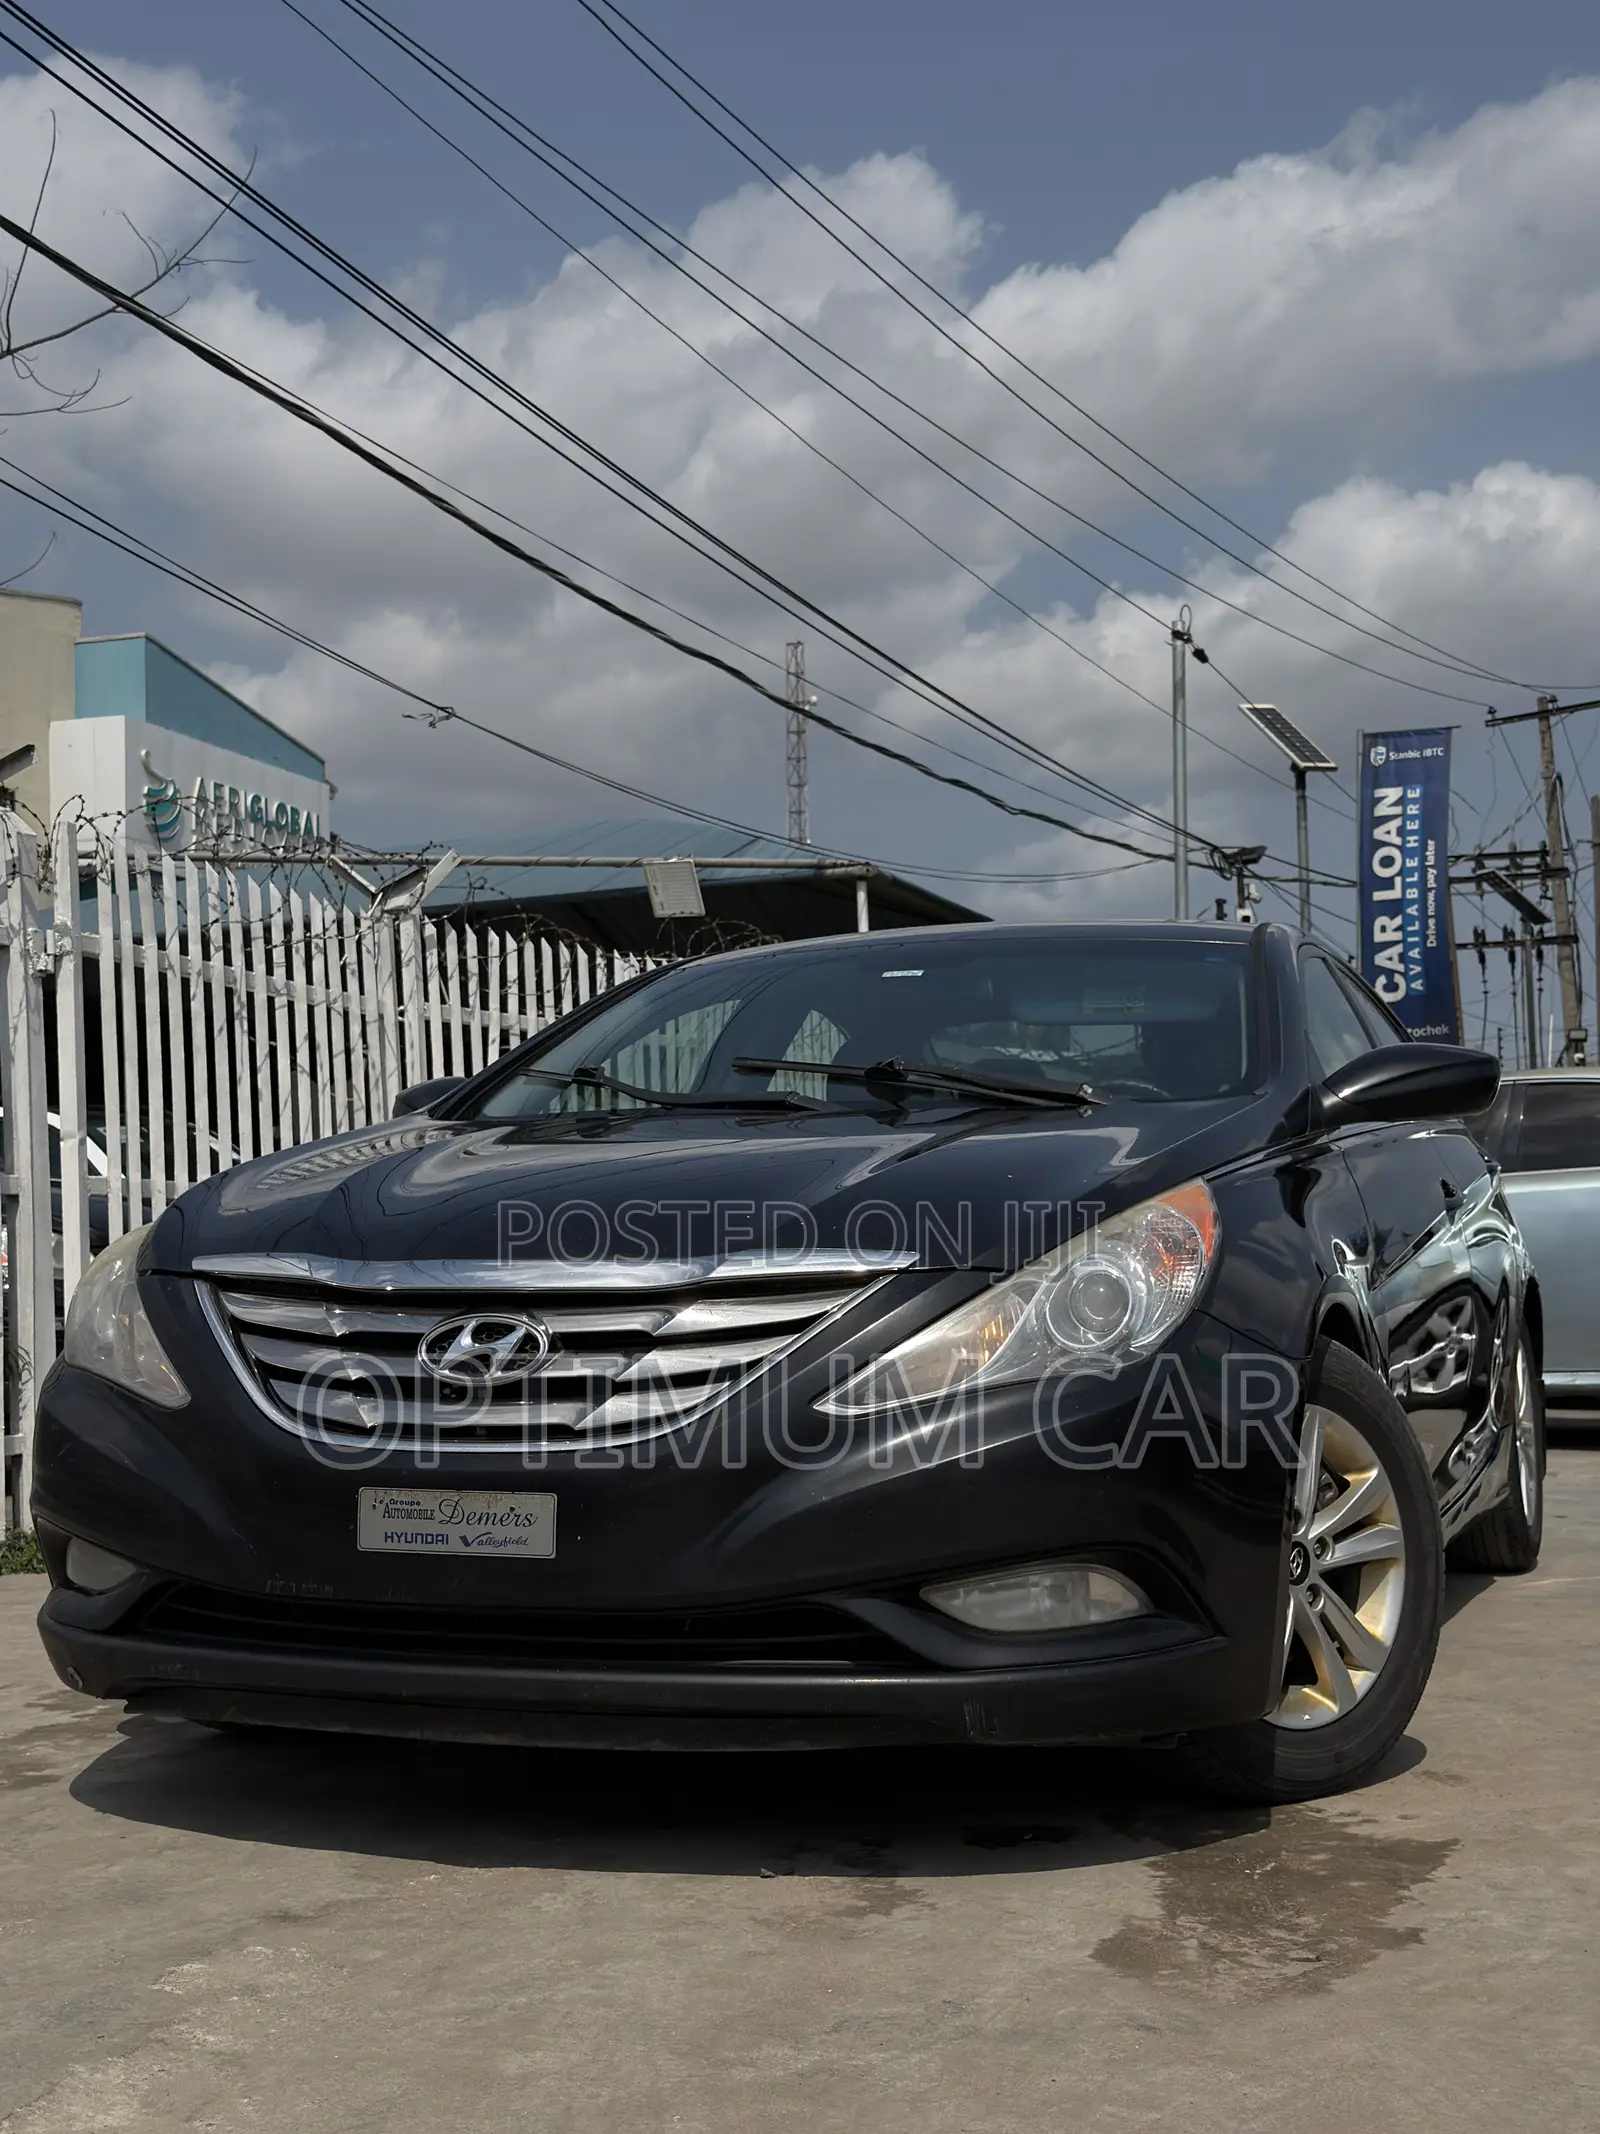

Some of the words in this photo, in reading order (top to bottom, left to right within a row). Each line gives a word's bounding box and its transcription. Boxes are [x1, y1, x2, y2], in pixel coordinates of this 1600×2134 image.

[1389, 749, 1421, 760] Stanbic
[1406, 787, 1420, 848] HERE
[1372, 786, 1404, 902] LOAN
[1425, 839, 1436, 865] later
[1426, 866, 1438, 888] pay
[1405, 856, 1425, 992] AVAILABLE
[1426, 917, 1437, 948] Drive
[1373, 914, 1407, 1004] CAR
[382, 1502, 436, 1521] AUTOMOBILE
[438, 1497, 539, 1528] Demers
[389, 1498, 421, 1507] Groupe
[384, 1531, 449, 1545] HYUNDAI
[458, 1531, 529, 1548] Valleyfield
